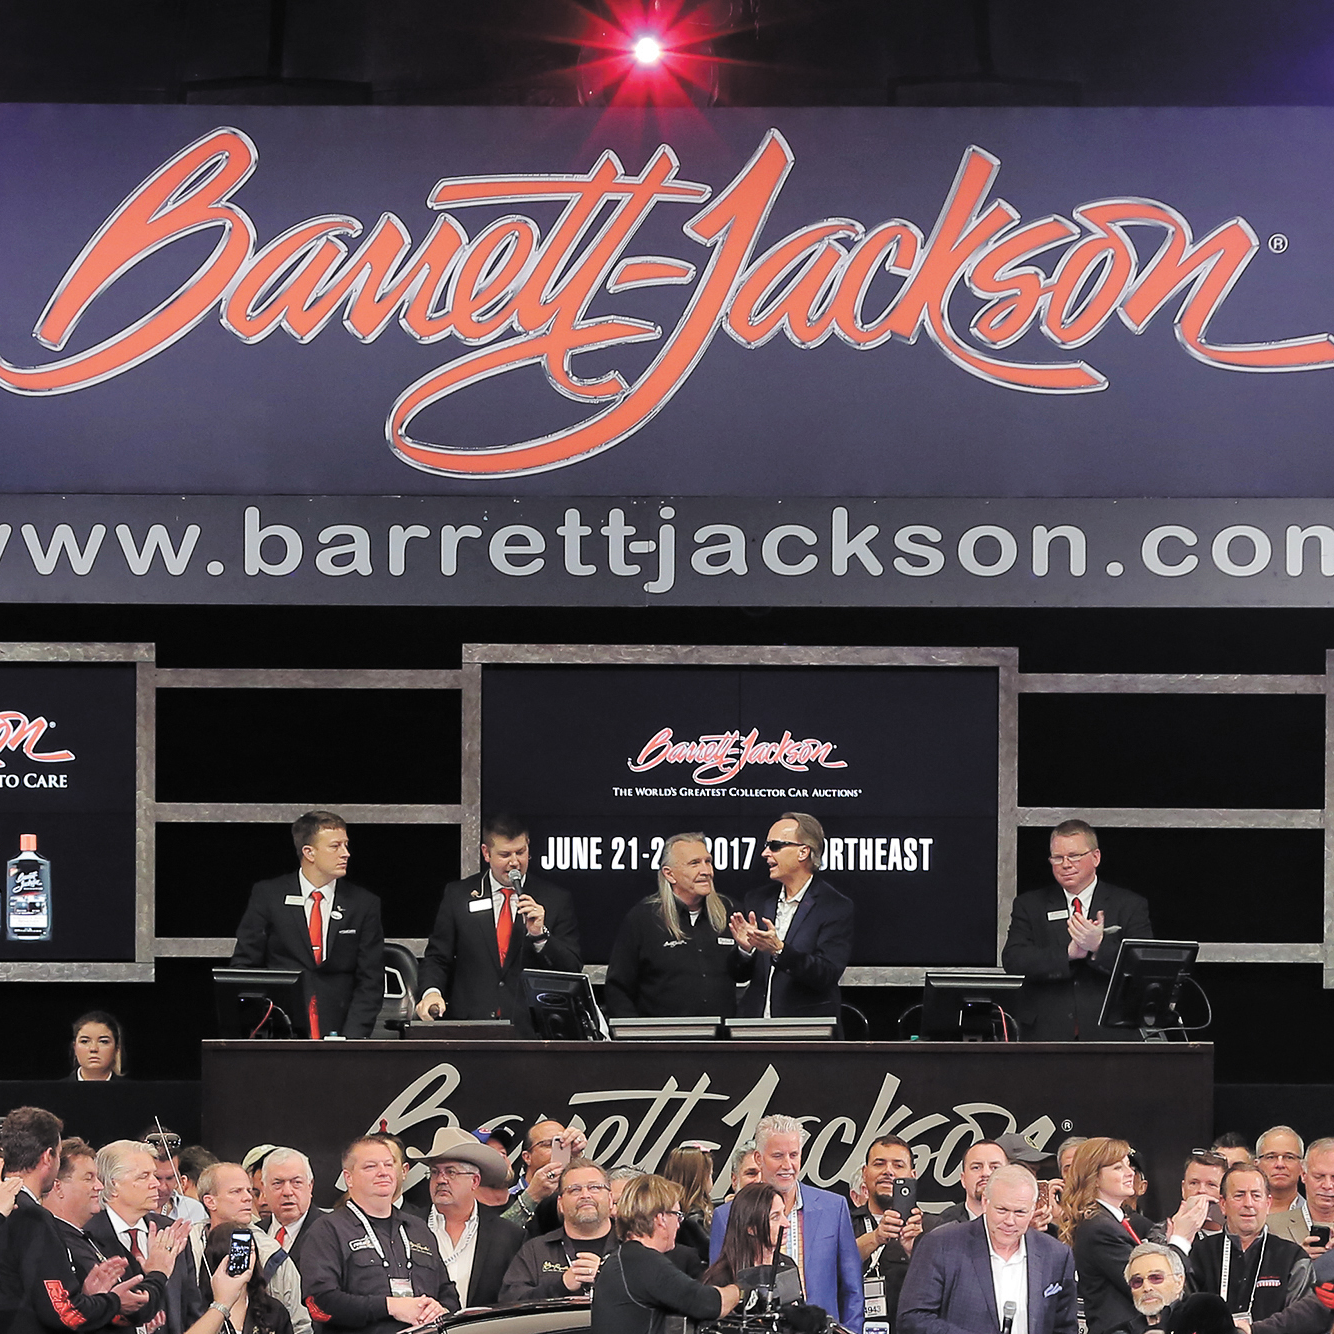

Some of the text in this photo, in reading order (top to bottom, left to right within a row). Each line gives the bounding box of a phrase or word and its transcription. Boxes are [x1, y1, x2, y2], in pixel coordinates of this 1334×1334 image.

[627, 727, 849, 786] Barrett-Jackson
[23, 773, 69, 790] CARE
[612, 786, 634, 798] THE
[679, 786, 727, 798] GREATEST
[728, 786, 786, 799] COLLECTOR
[787, 787, 809, 799] CAR
[540, 836, 603, 871] JUNE
[610, 836, 667, 871] 21-2
[705, 836, 757, 871] 017
